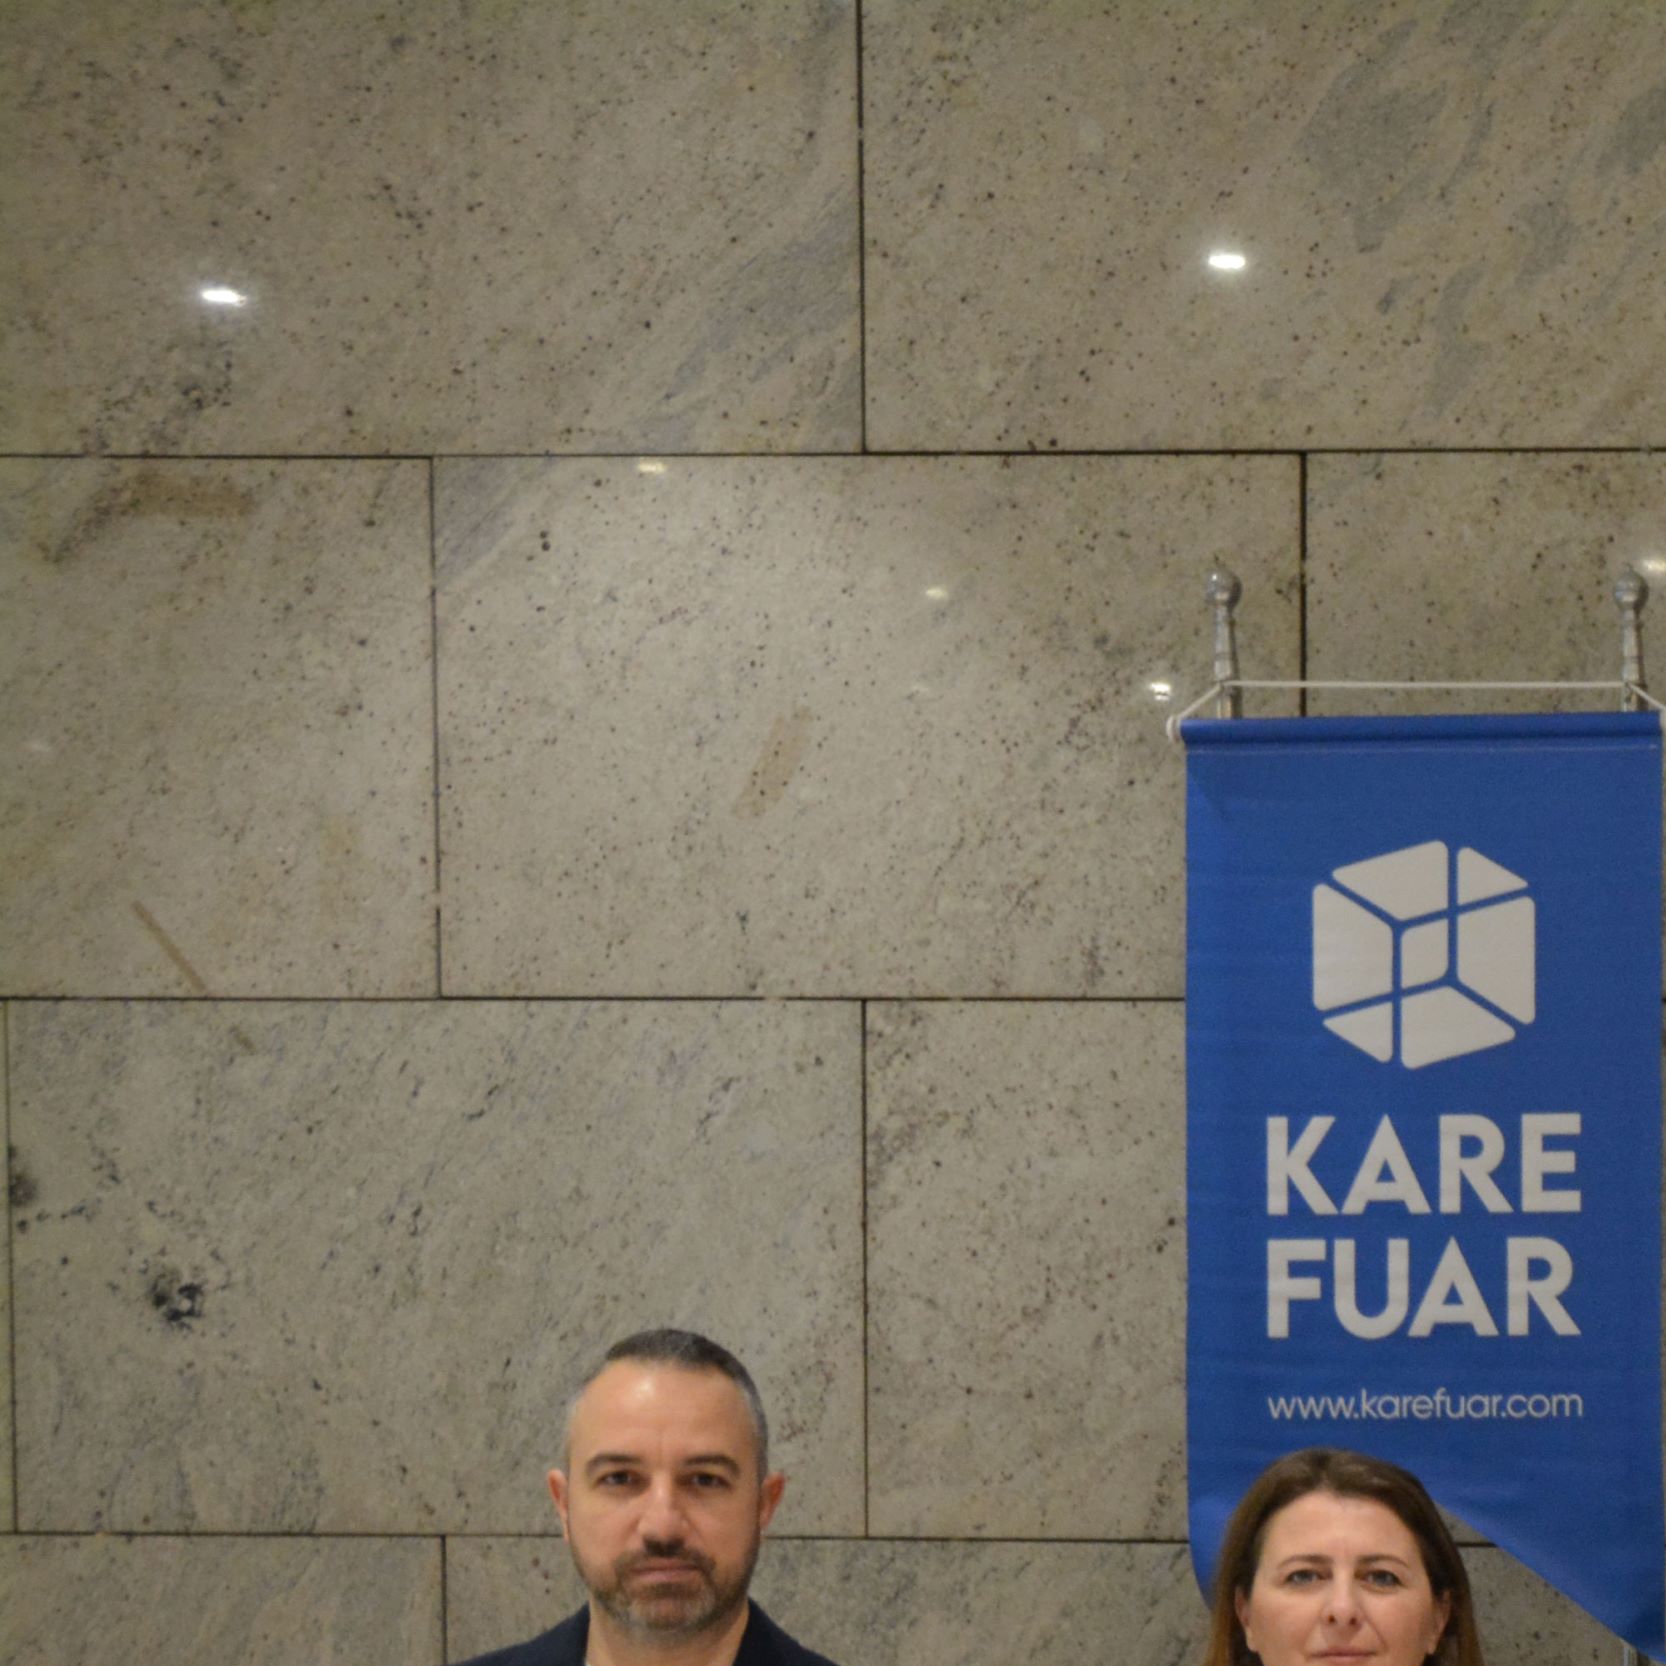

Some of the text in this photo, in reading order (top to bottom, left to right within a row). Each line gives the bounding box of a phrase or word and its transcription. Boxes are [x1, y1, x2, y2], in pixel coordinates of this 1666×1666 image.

[1266, 1111, 1583, 1217] KARE
[1266, 1235, 1583, 1340] FUAR
[1266, 1387, 1584, 1421] www.karefuar.com
